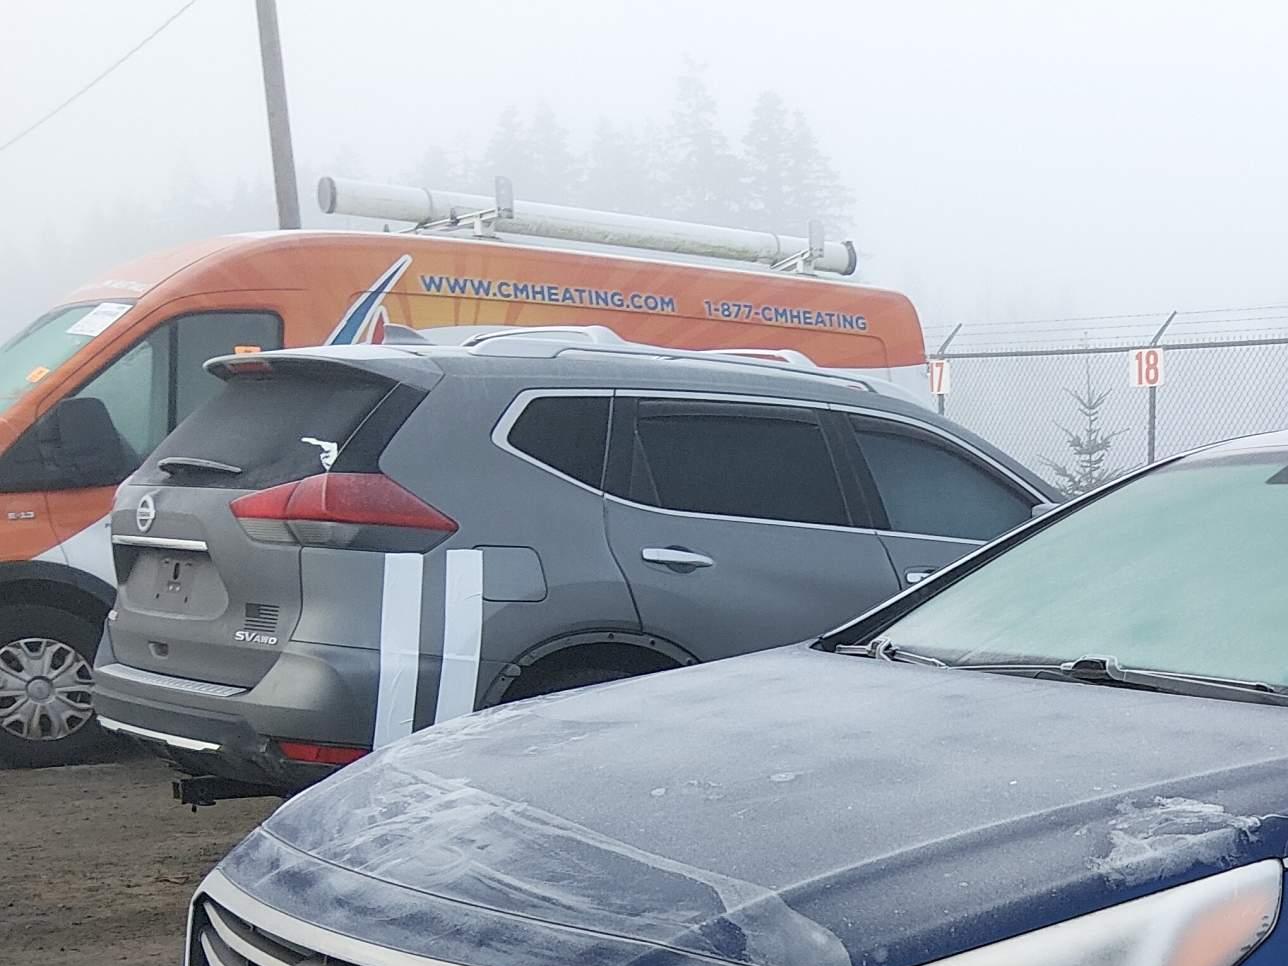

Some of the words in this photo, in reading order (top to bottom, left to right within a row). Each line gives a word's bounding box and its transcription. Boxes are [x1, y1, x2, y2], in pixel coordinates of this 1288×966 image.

[420, 274, 676, 312] WWW.CMHEATING.COM
[704, 300, 868, 331] 1-877-CMHEATING
[1135, 350, 1159, 385] 18
